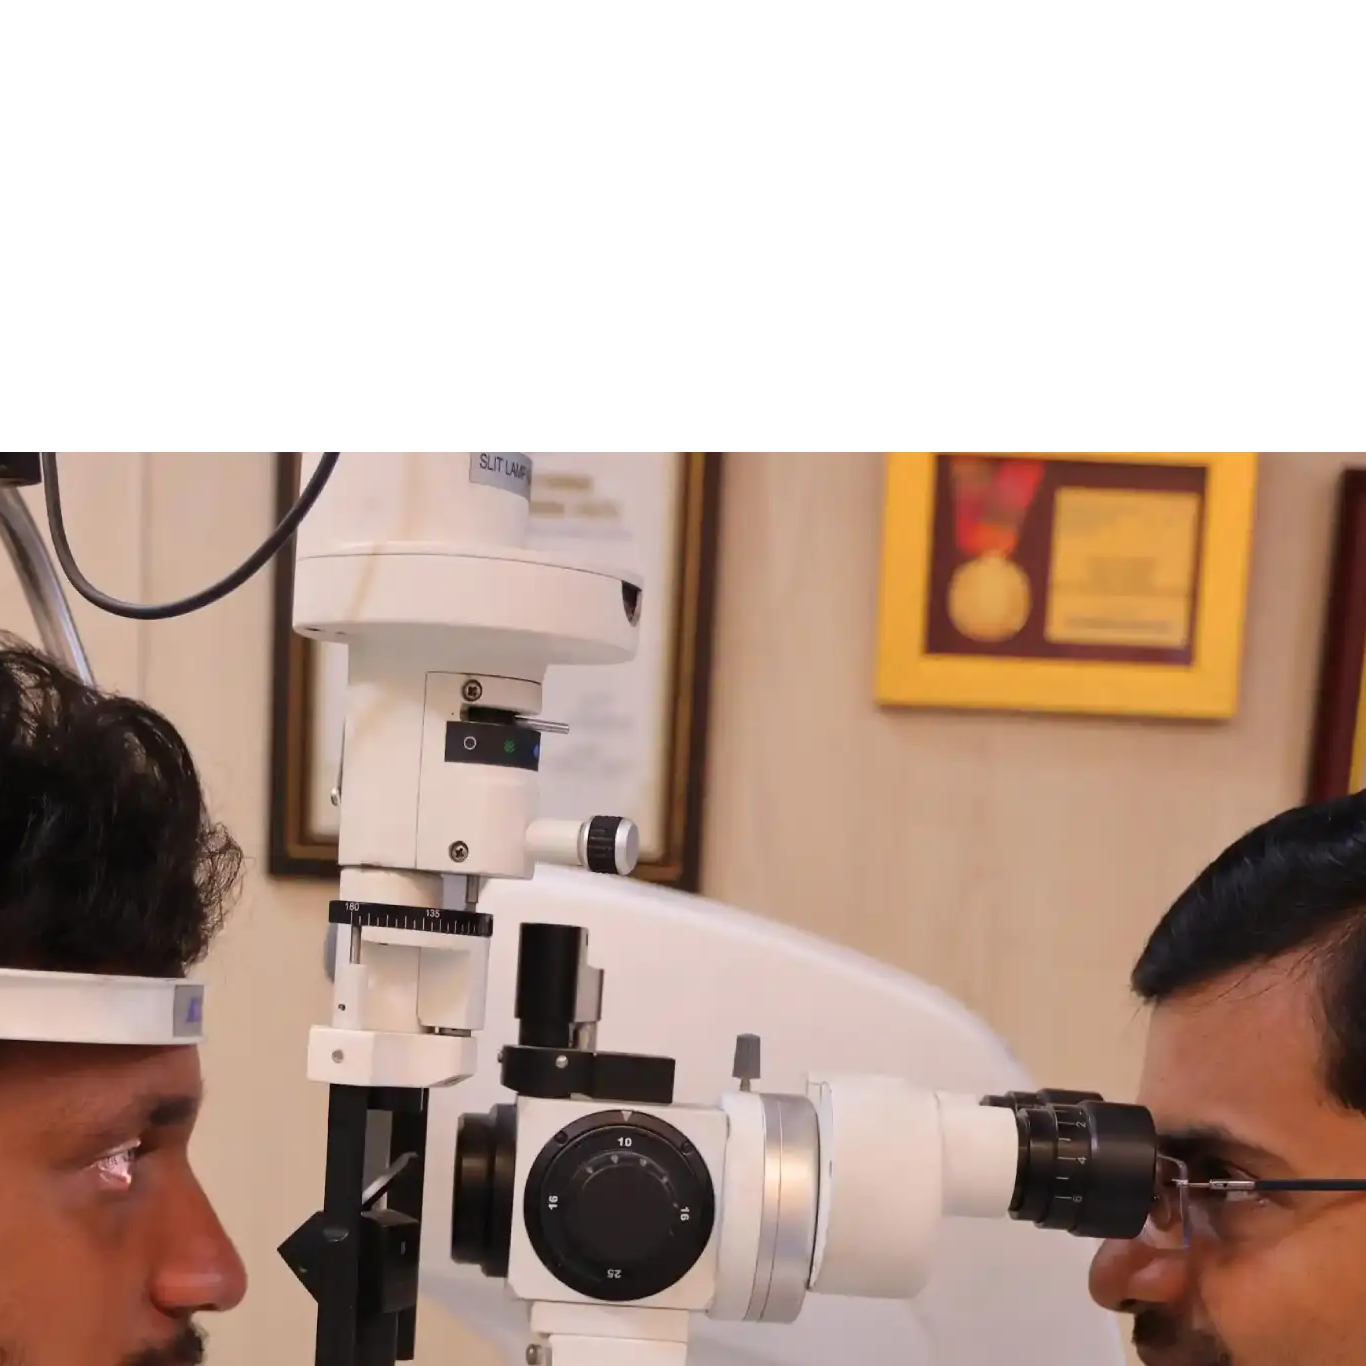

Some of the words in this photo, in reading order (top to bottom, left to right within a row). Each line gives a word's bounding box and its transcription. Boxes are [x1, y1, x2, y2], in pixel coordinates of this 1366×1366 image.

[479, 453, 503, 473] SLIT
[345, 902, 360, 912] 180
[426, 909, 441, 918] 135
[617, 1137, 632, 1147] 10
[548, 1195, 559, 1210] 16
[680, 1206, 690, 1221] 16
[607, 1269, 622, 1279] 25
